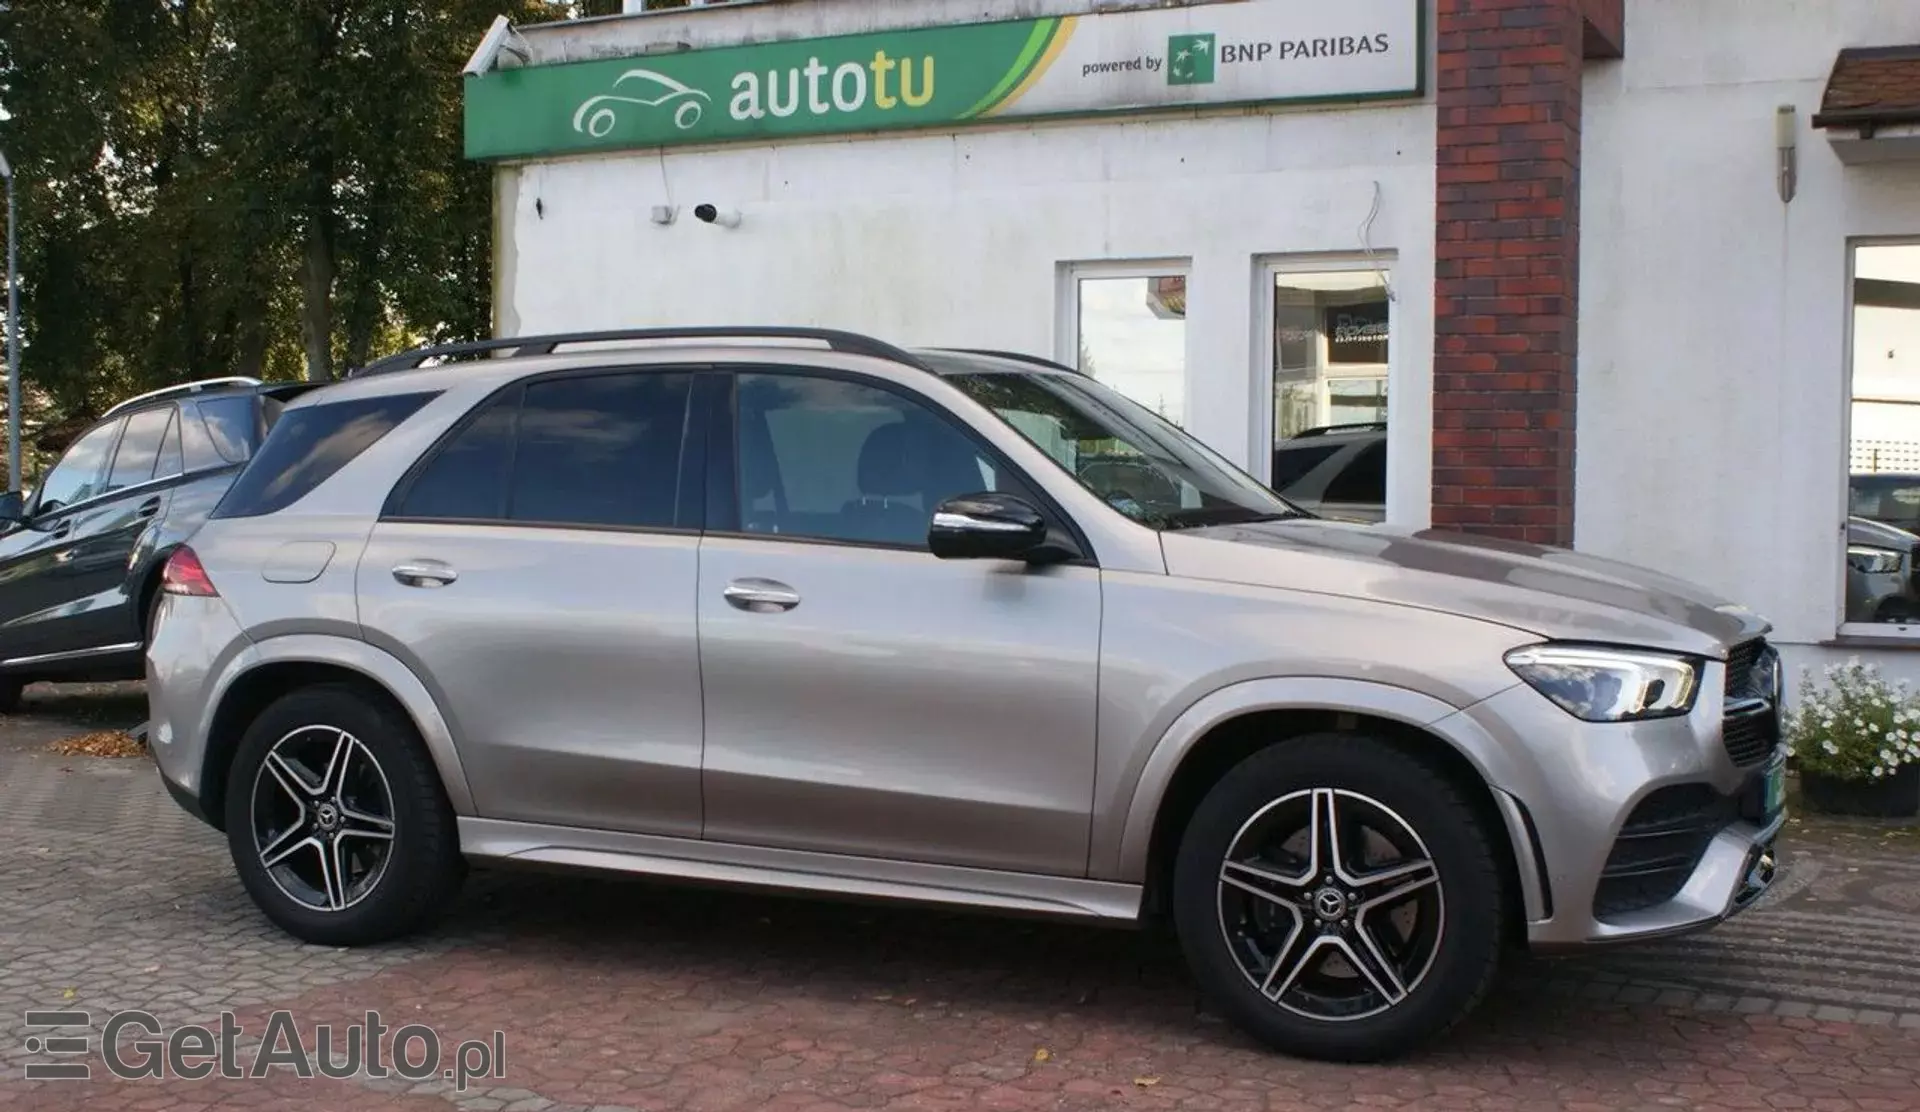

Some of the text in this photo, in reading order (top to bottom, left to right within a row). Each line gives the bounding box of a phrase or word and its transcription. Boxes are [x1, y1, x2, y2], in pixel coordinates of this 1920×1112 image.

[1220, 33, 1389, 64] BNP PARIBAS
[1082, 56, 1162, 77] powered by
[729, 50, 935, 121] autotu
